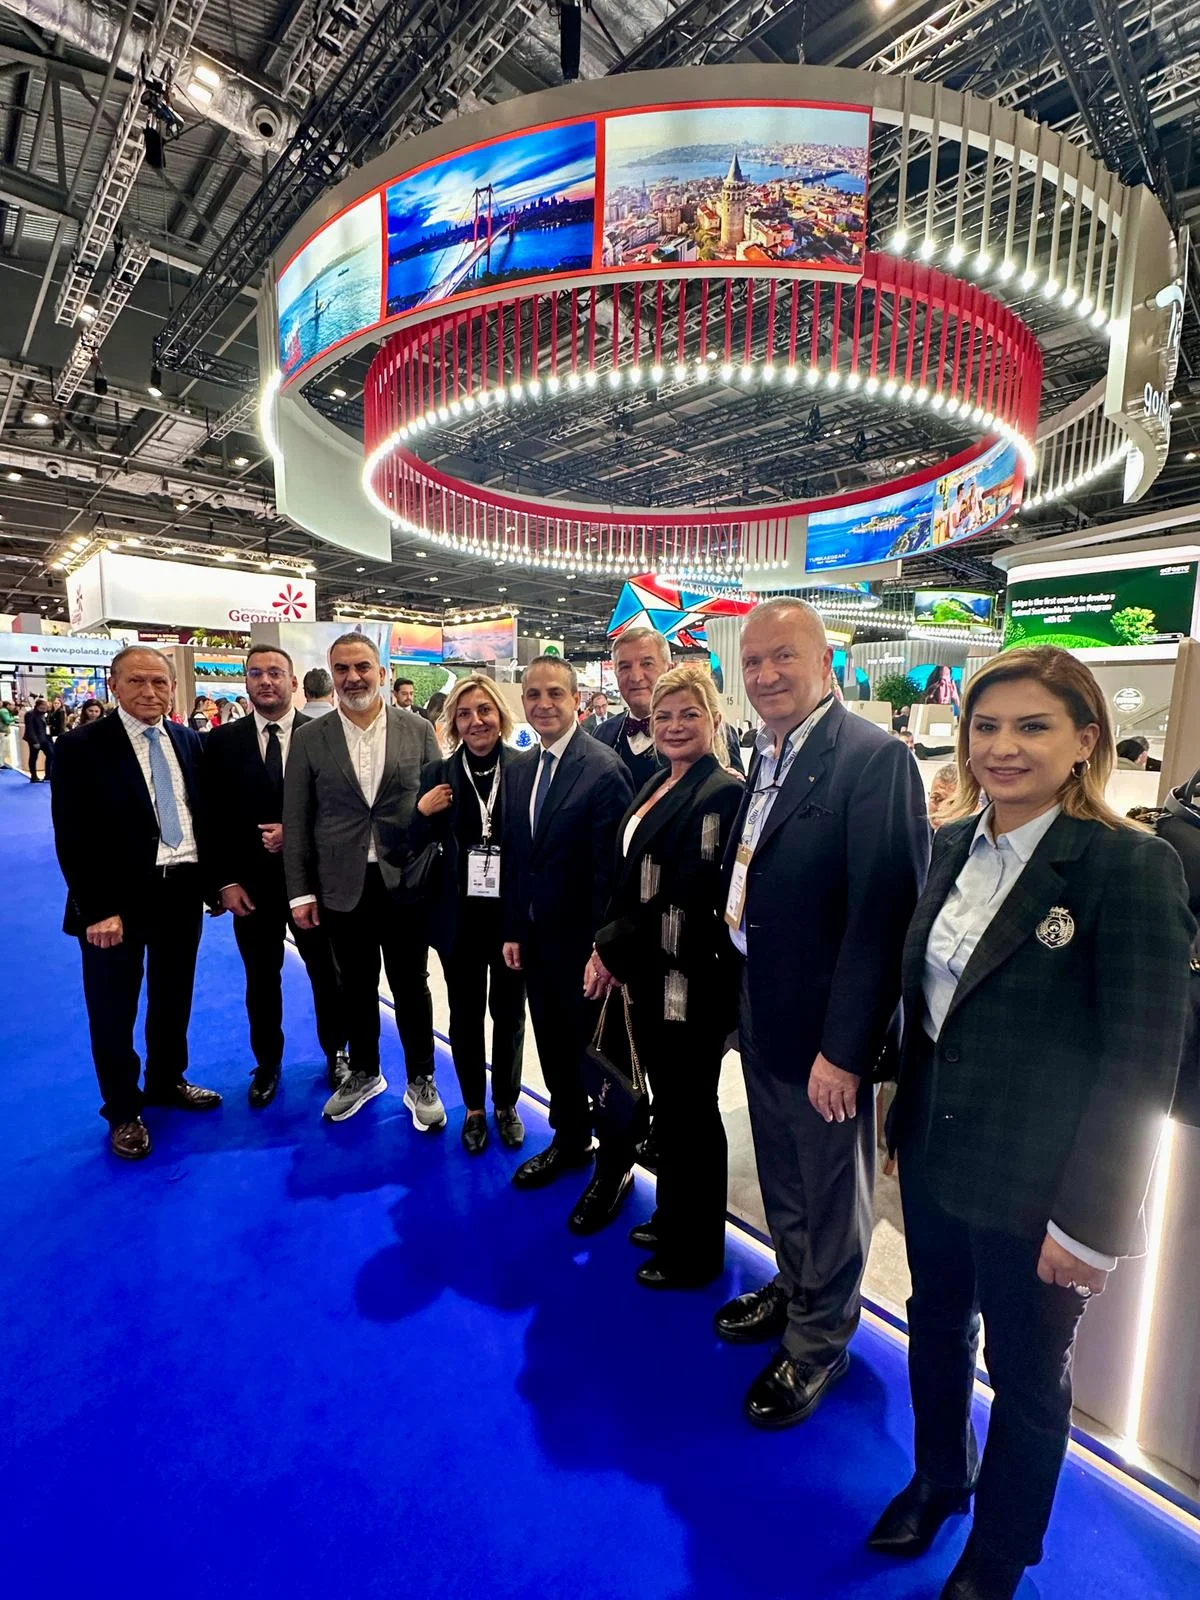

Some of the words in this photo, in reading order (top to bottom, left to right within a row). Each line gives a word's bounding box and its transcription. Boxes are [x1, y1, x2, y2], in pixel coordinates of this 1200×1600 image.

[1034, 598, 1043, 606] the
[1044, 597, 1056, 605] first
[1057, 596, 1078, 604] country
[1087, 593, 1110, 602] develop
[726, 696, 734, 706] 15
